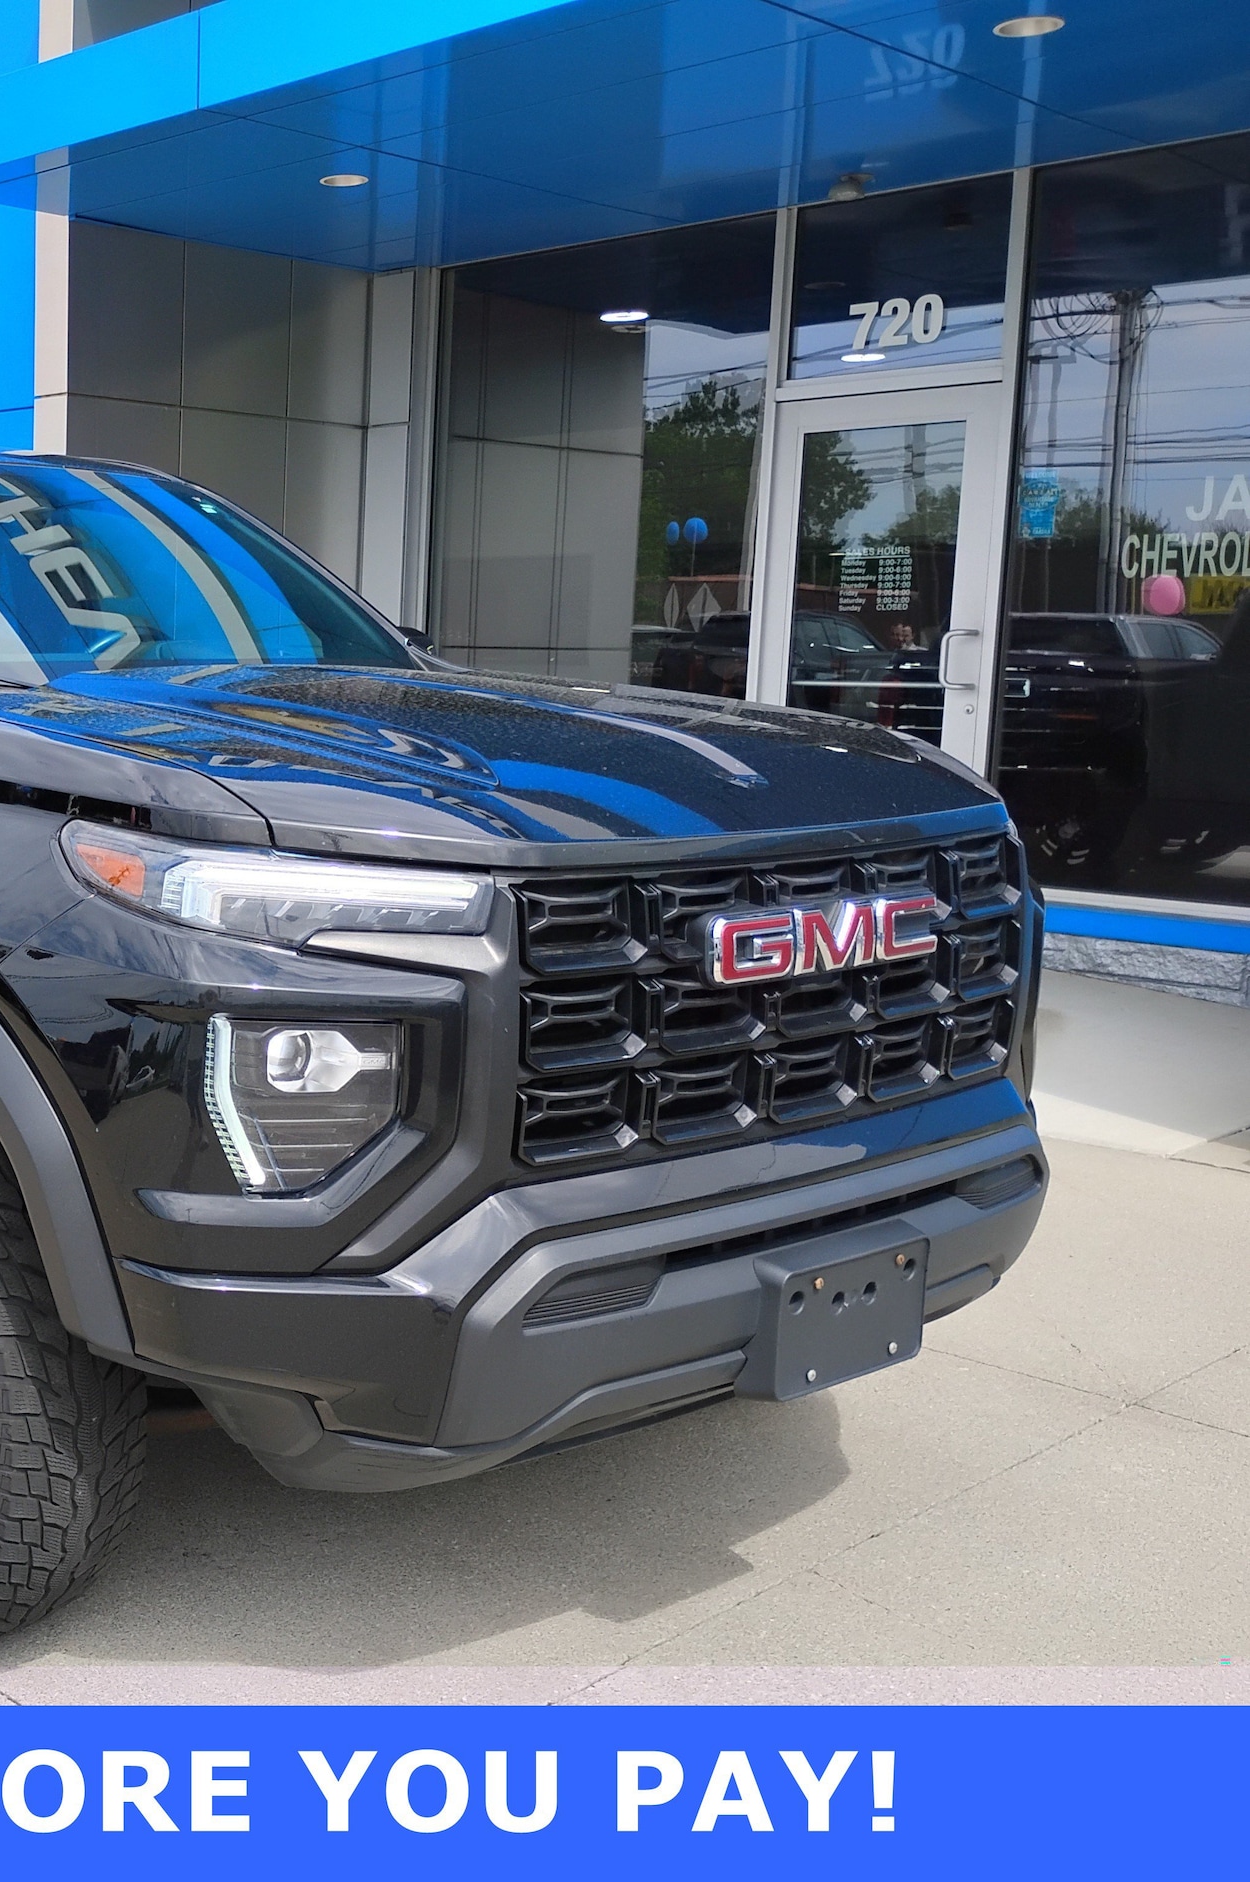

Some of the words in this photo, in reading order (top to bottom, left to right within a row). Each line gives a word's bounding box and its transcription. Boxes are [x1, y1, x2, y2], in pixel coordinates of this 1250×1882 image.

[849, 293, 945, 350] 720
[845, 547, 875, 556] SALES
[876, 546, 911, 555] HOURS
[878, 558, 913, 566] 9:00-7:00
[840, 582, 869, 590] Thursday
[877, 581, 911, 589] 9:00-7:00
[838, 597, 867, 605] Saturday
[876, 603, 909, 611] CLOSED
[712, 895, 938, 984] GMC
